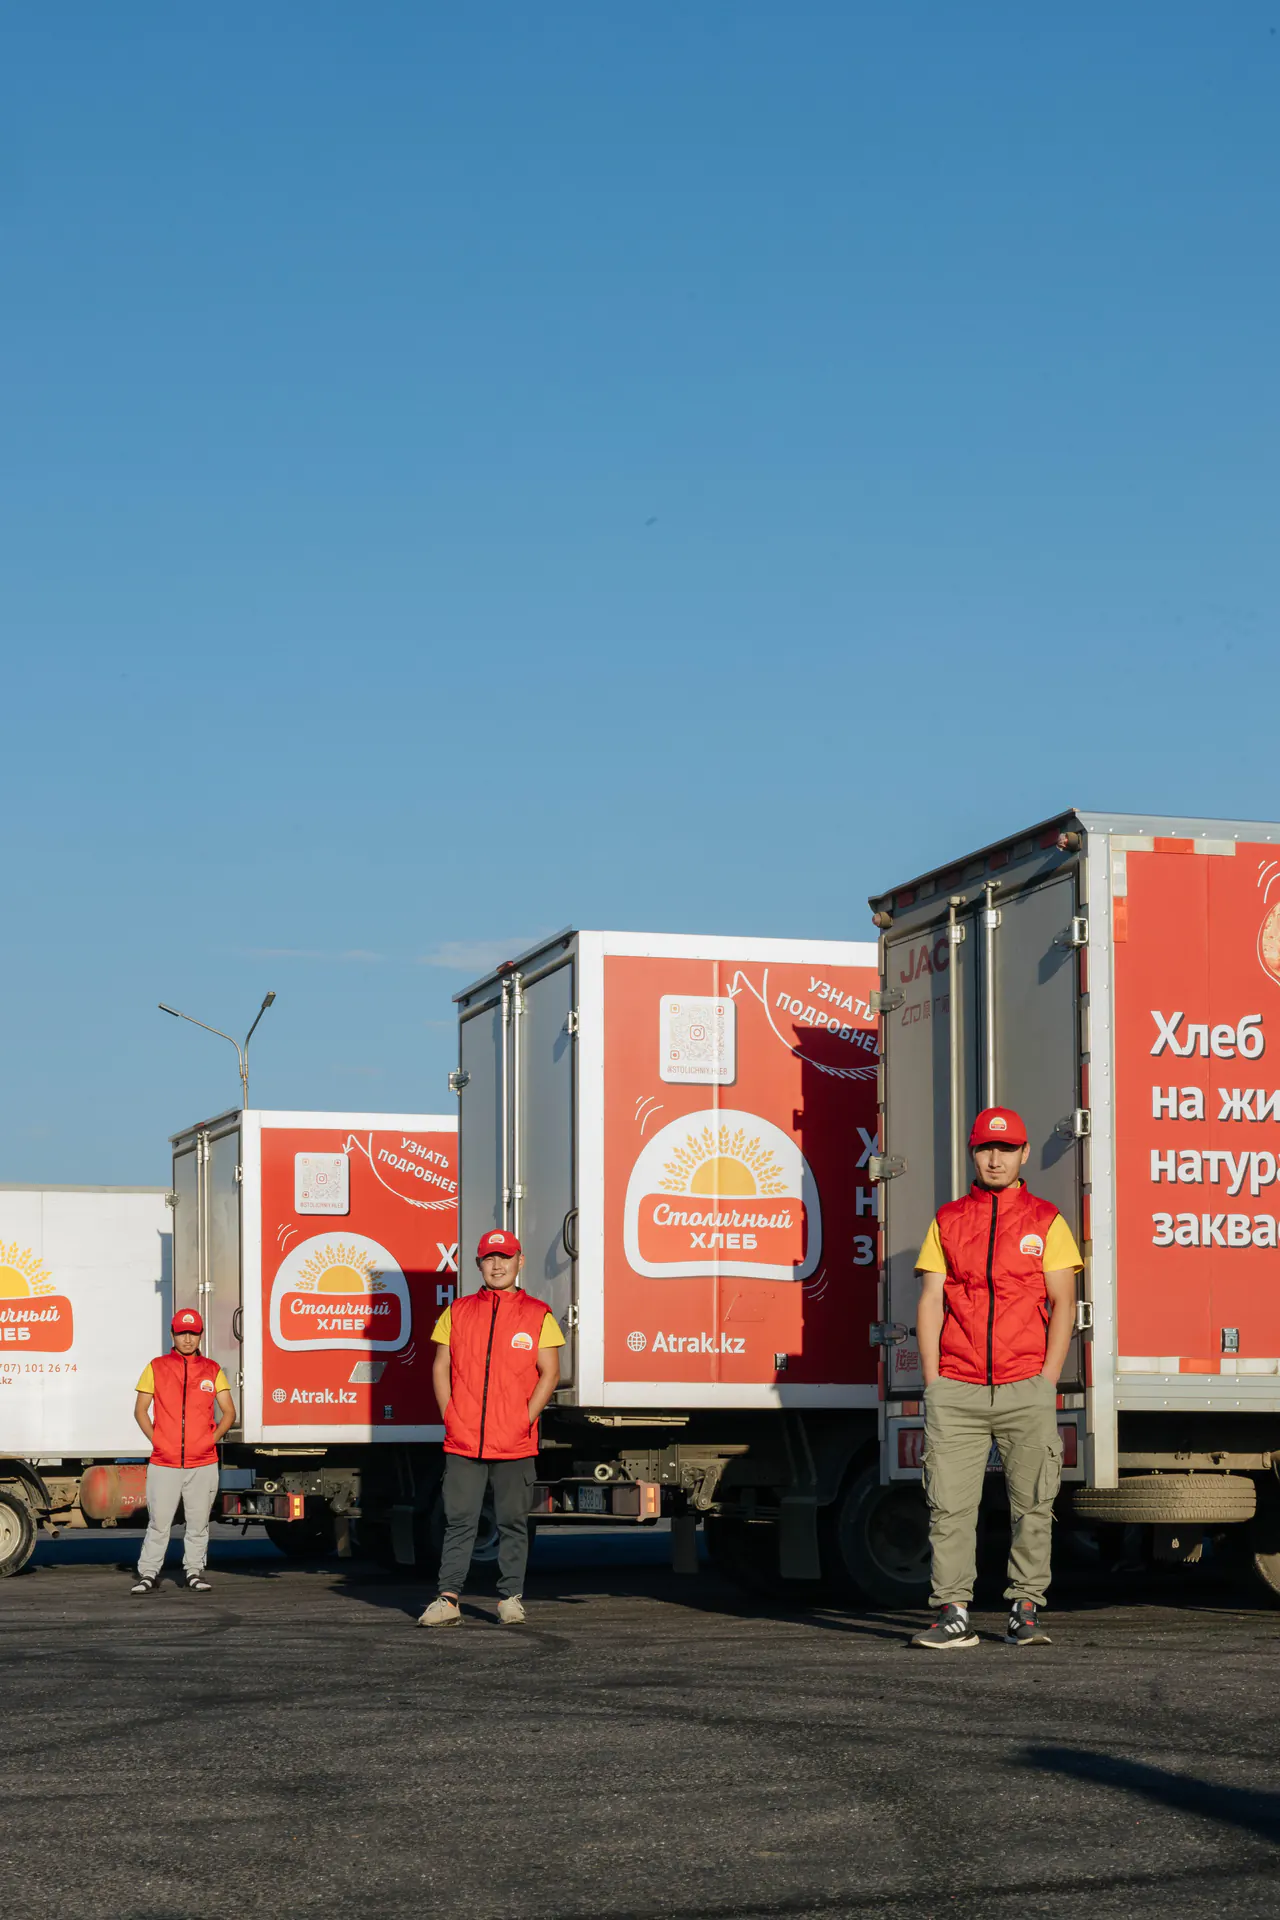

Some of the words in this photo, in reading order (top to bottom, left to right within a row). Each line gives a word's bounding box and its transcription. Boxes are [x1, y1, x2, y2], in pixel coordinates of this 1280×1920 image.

[900, 938, 950, 983] JAC
[807, 976, 876, 1022] УЗНАТЬ
[1150, 1010, 1265, 1060] Хлеб
[1152, 1086, 1205, 1120] на
[400, 1136, 450, 1169] УЗНАТЬ
[377, 1148, 458, 1194] ПОДРОБНЕЕ
[1150, 1149, 1280, 1197] натур
[652, 1203, 794, 1229] Столичный
[1151, 1212, 1280, 1248] заква
[689, 1232, 758, 1250] ХЛЕБ
[290, 1298, 391, 1316] Столичный
[0, 1327, 31, 1341] ЕБ
[316, 1318, 366, 1331] ХЛЕБ
[651, 1331, 746, 1354] Atrak.kz
[25, 1363, 44, 1373] 101
[48, 1363, 61, 1373] 26
[64, 1363, 78, 1373] 74
[290, 1387, 357, 1404] Atrak.kz
